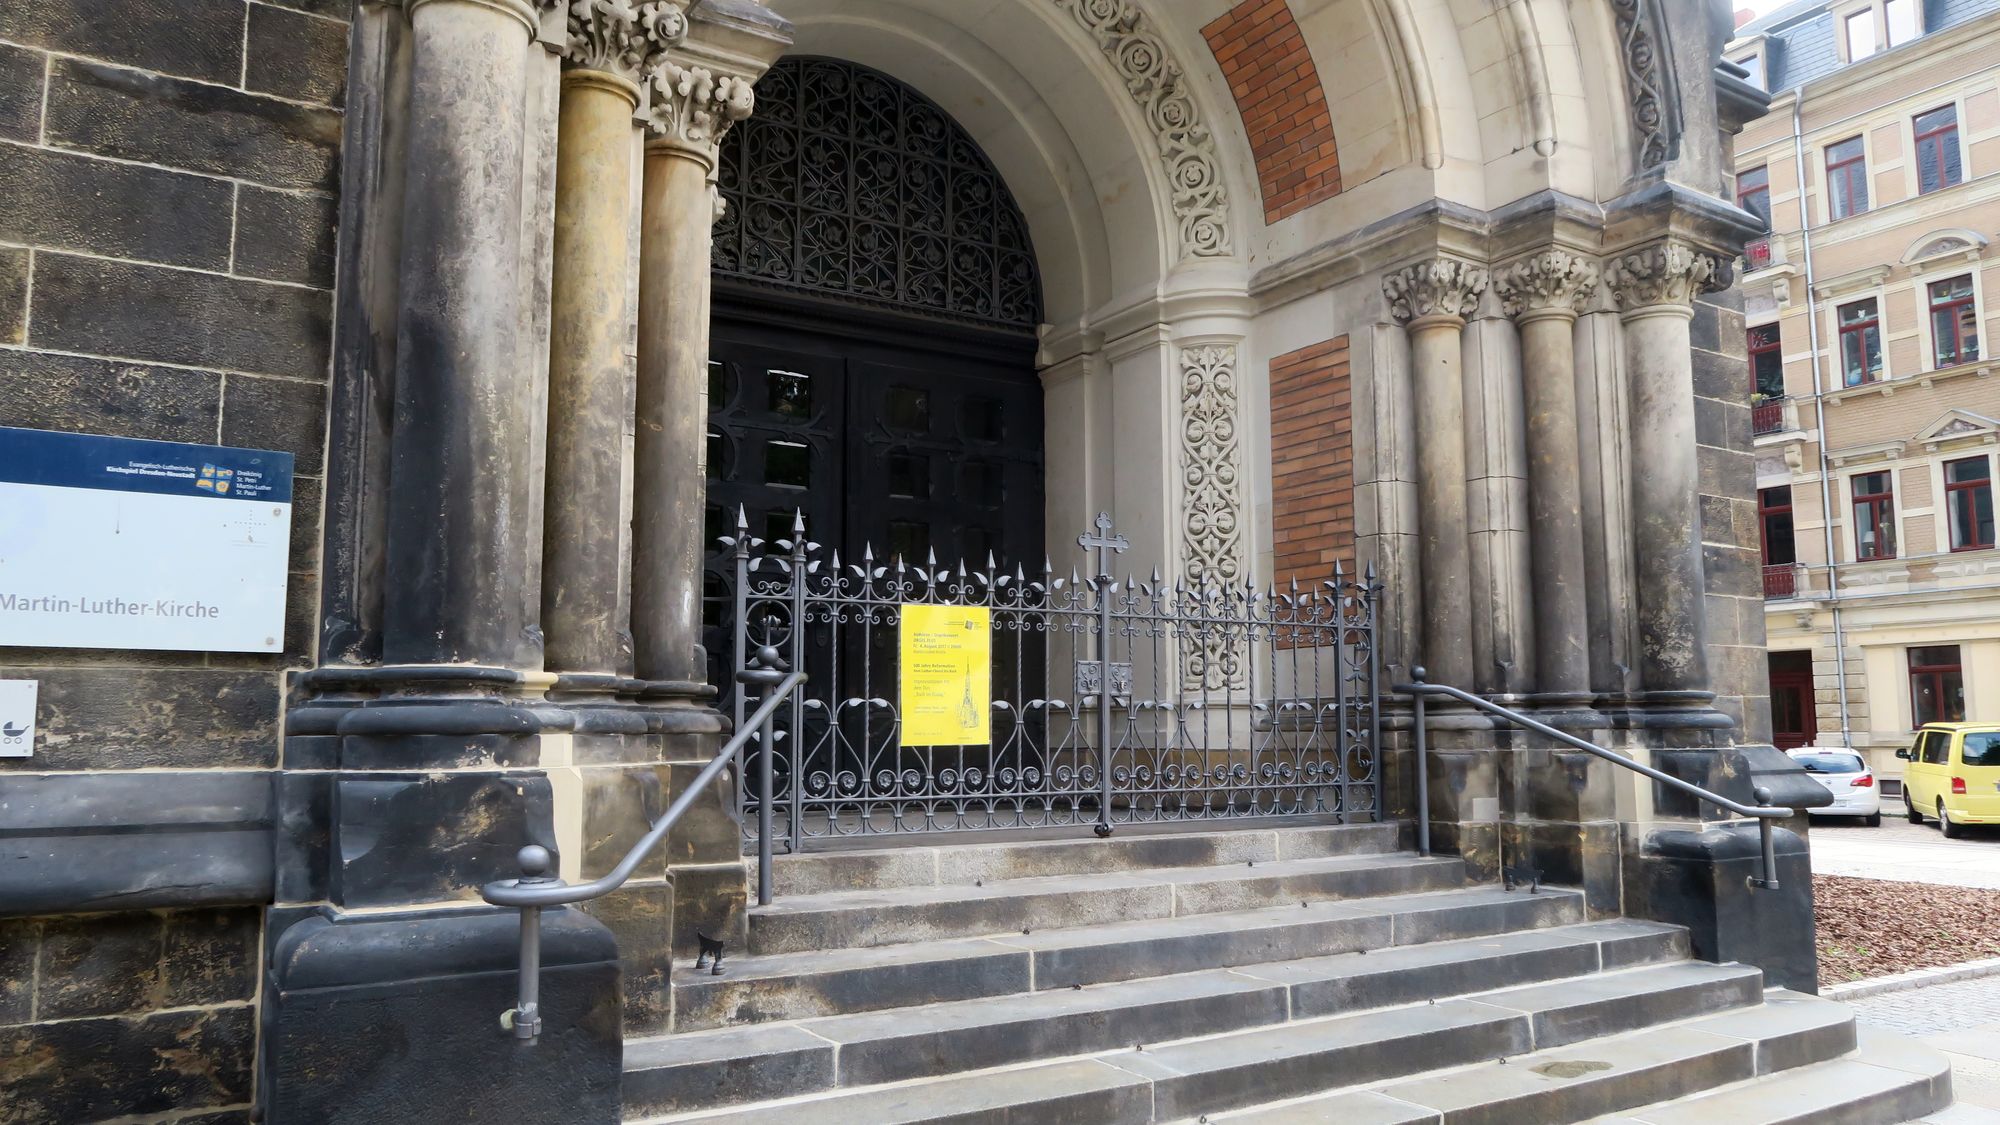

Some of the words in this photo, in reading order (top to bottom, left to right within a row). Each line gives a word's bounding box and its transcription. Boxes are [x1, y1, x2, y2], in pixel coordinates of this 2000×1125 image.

[106, 466, 138, 475] Kirchspiel
[139, 468, 196, 479] Dresden-Neustadt
[0, 593, 219, 618] Martin-Luther-Kirche
